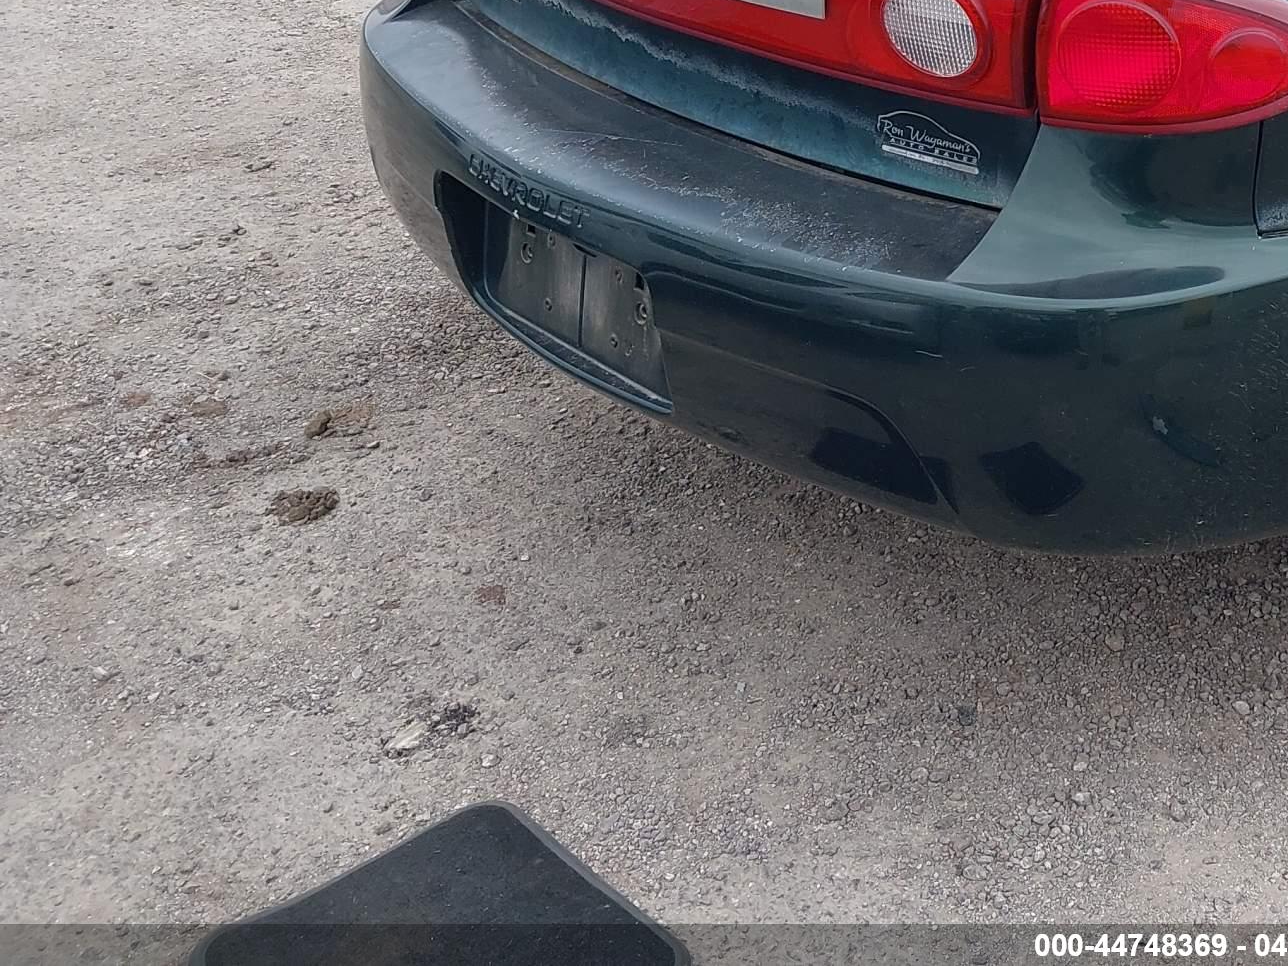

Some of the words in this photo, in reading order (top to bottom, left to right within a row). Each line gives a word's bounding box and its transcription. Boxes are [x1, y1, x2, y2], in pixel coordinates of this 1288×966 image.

[881, 119, 904, 138] Ron
[905, 125, 970, 153] Wayaman's
[889, 138, 924, 150] AUTO
[934, 146, 978, 165] SALES
[468, 153, 590, 228] CHEVROLET
